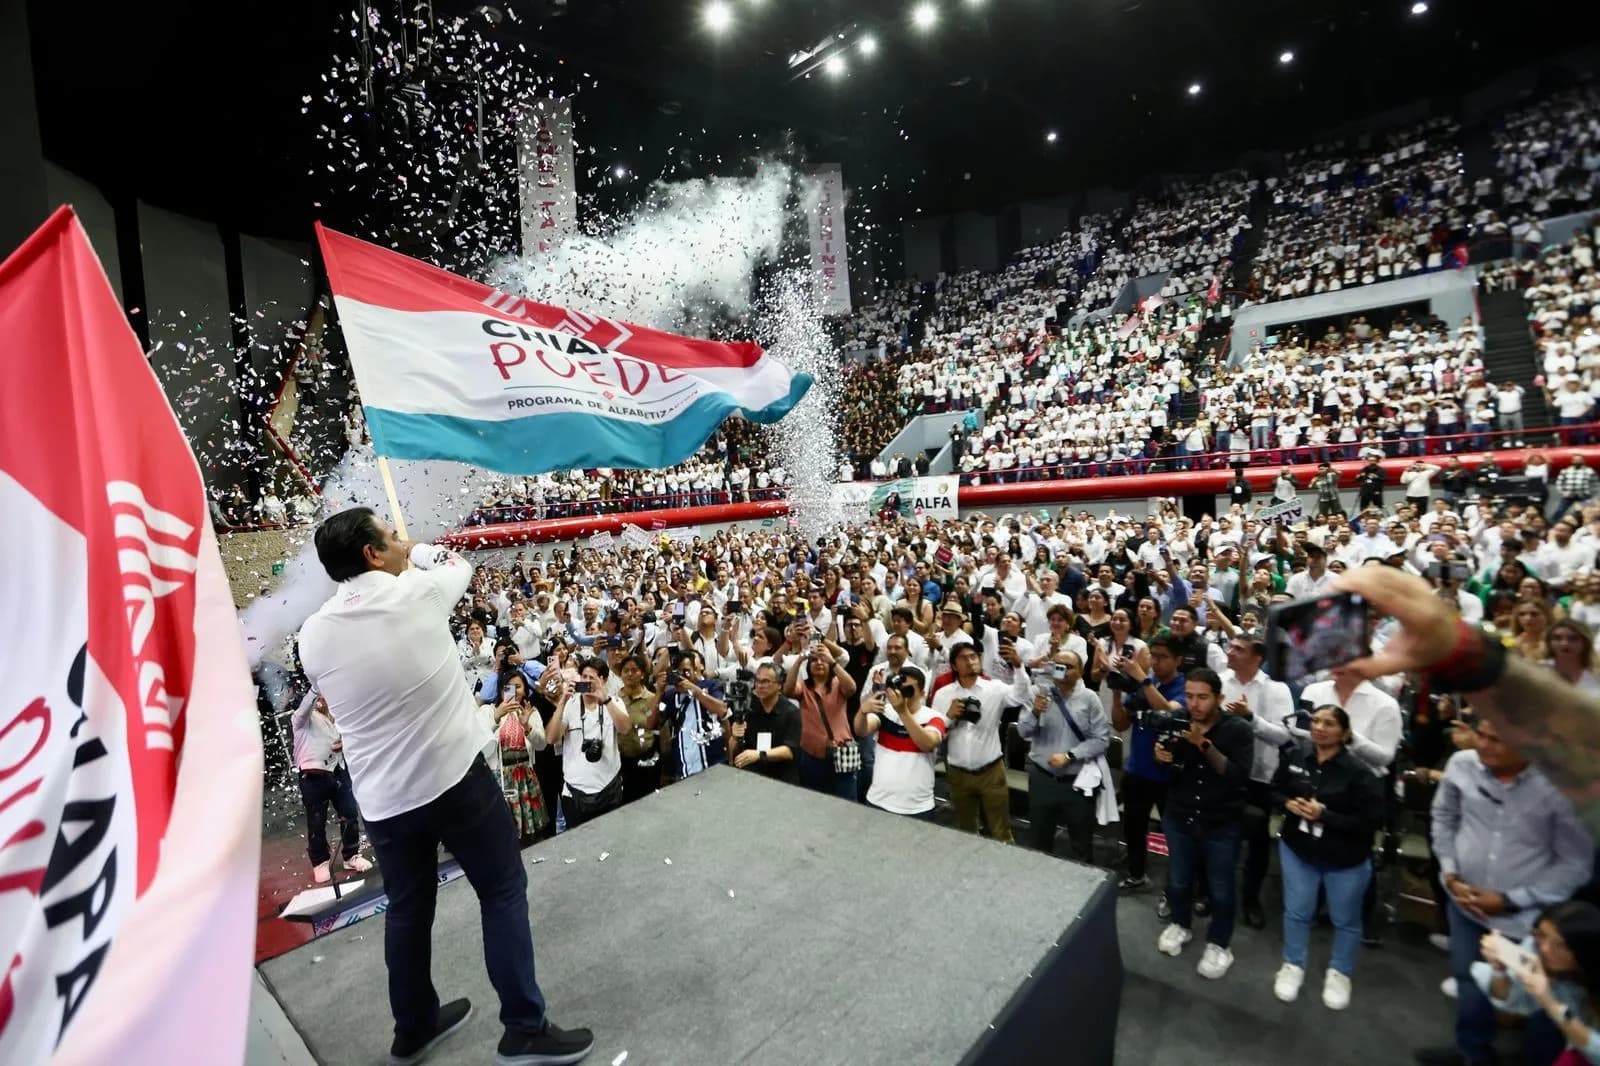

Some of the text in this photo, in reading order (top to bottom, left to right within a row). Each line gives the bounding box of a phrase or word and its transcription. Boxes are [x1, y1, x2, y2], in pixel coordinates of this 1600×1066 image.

[482, 319, 608, 355] CHIA
[507, 396, 583, 410] PROGRAMA
[588, 400, 603, 411] DE
[914, 496, 952, 509] ALFA
